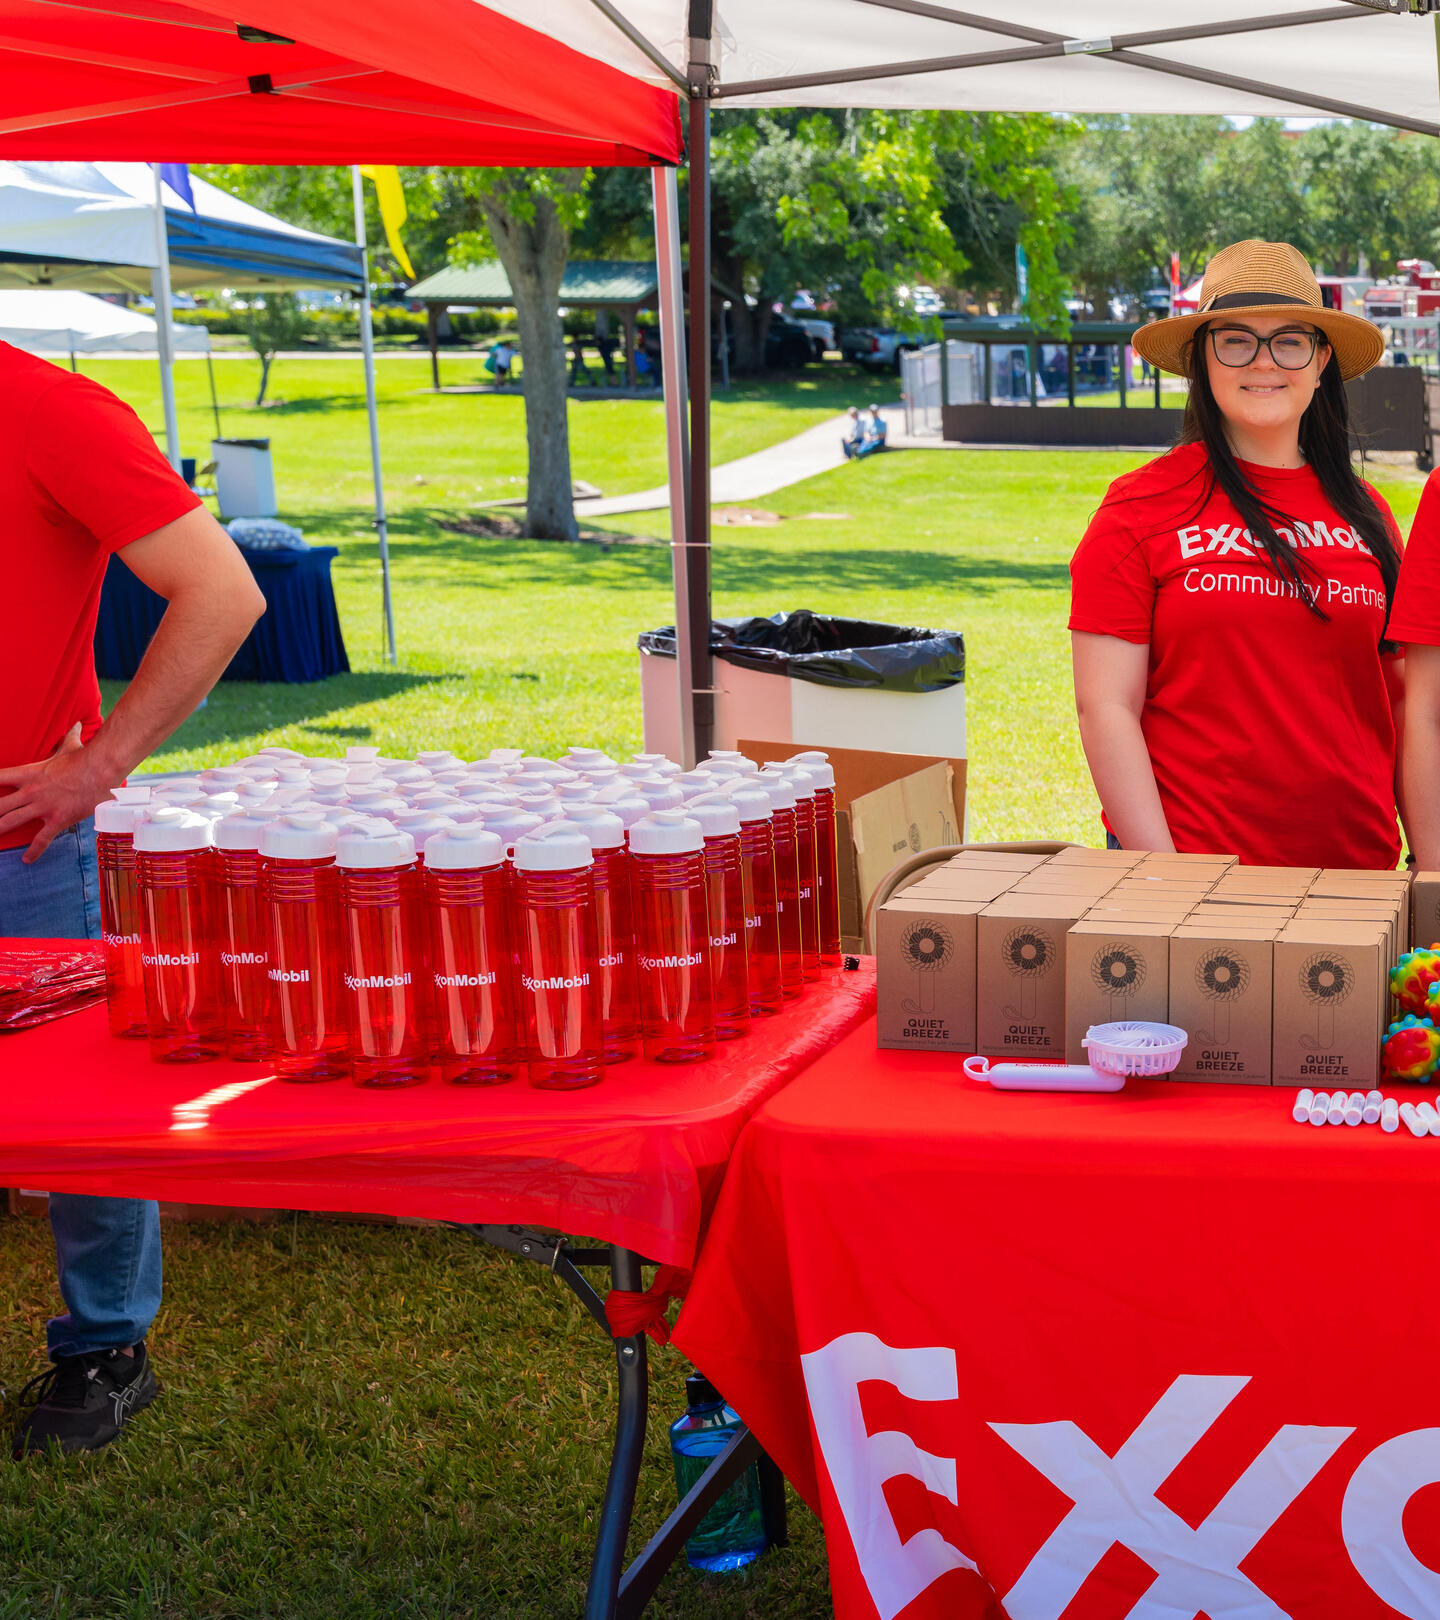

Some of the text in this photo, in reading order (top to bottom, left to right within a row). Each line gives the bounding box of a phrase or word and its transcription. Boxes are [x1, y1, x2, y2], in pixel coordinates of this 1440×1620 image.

[1327, 578, 1387, 611] Partner
[103, 932, 142, 948] ExxonM
[908, 1018, 945, 1029] QUIET
[903, 1028, 950, 1039] BREEZE
[1008, 1025, 1046, 1036] QUIET
[1003, 1035, 1051, 1046] BREEZE
[1201, 1050, 1240, 1061] QUIET
[1305, 1055, 1344, 1065] QUIET
[1196, 1060, 1245, 1072] BREEZE
[1300, 1065, 1349, 1076] BREEZE
